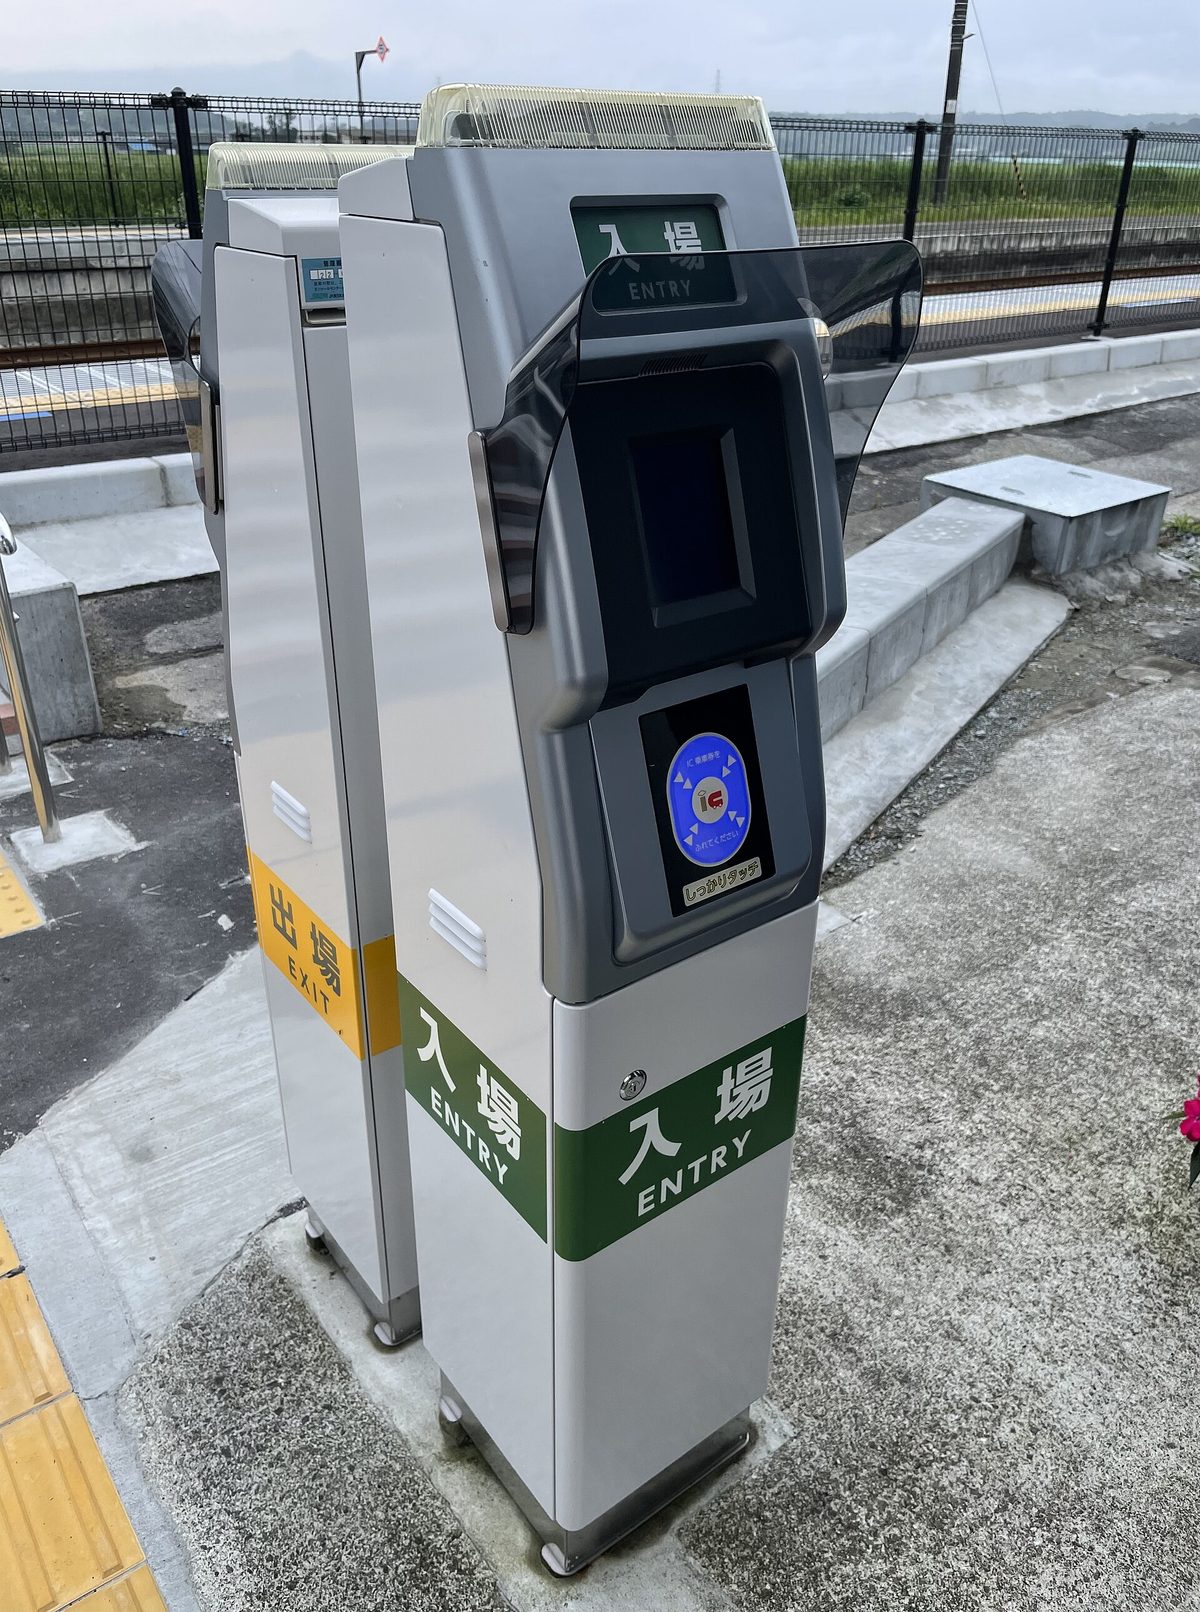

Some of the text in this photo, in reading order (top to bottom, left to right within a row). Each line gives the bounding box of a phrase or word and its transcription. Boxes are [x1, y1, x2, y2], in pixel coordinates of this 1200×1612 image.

[598, 220, 706, 276] 入場
[628, 279, 691, 301] ENTRY
[695, 830, 740, 852] ふれてください
[269, 882, 341, 998] 出場
[288, 954, 330, 1015] EXIT
[416, 1006, 522, 1161] 入場
[618, 1046, 774, 1186] 入場
[430, 1086, 509, 1186] ENTRY
[637, 1129, 752, 1218] ENTRY
